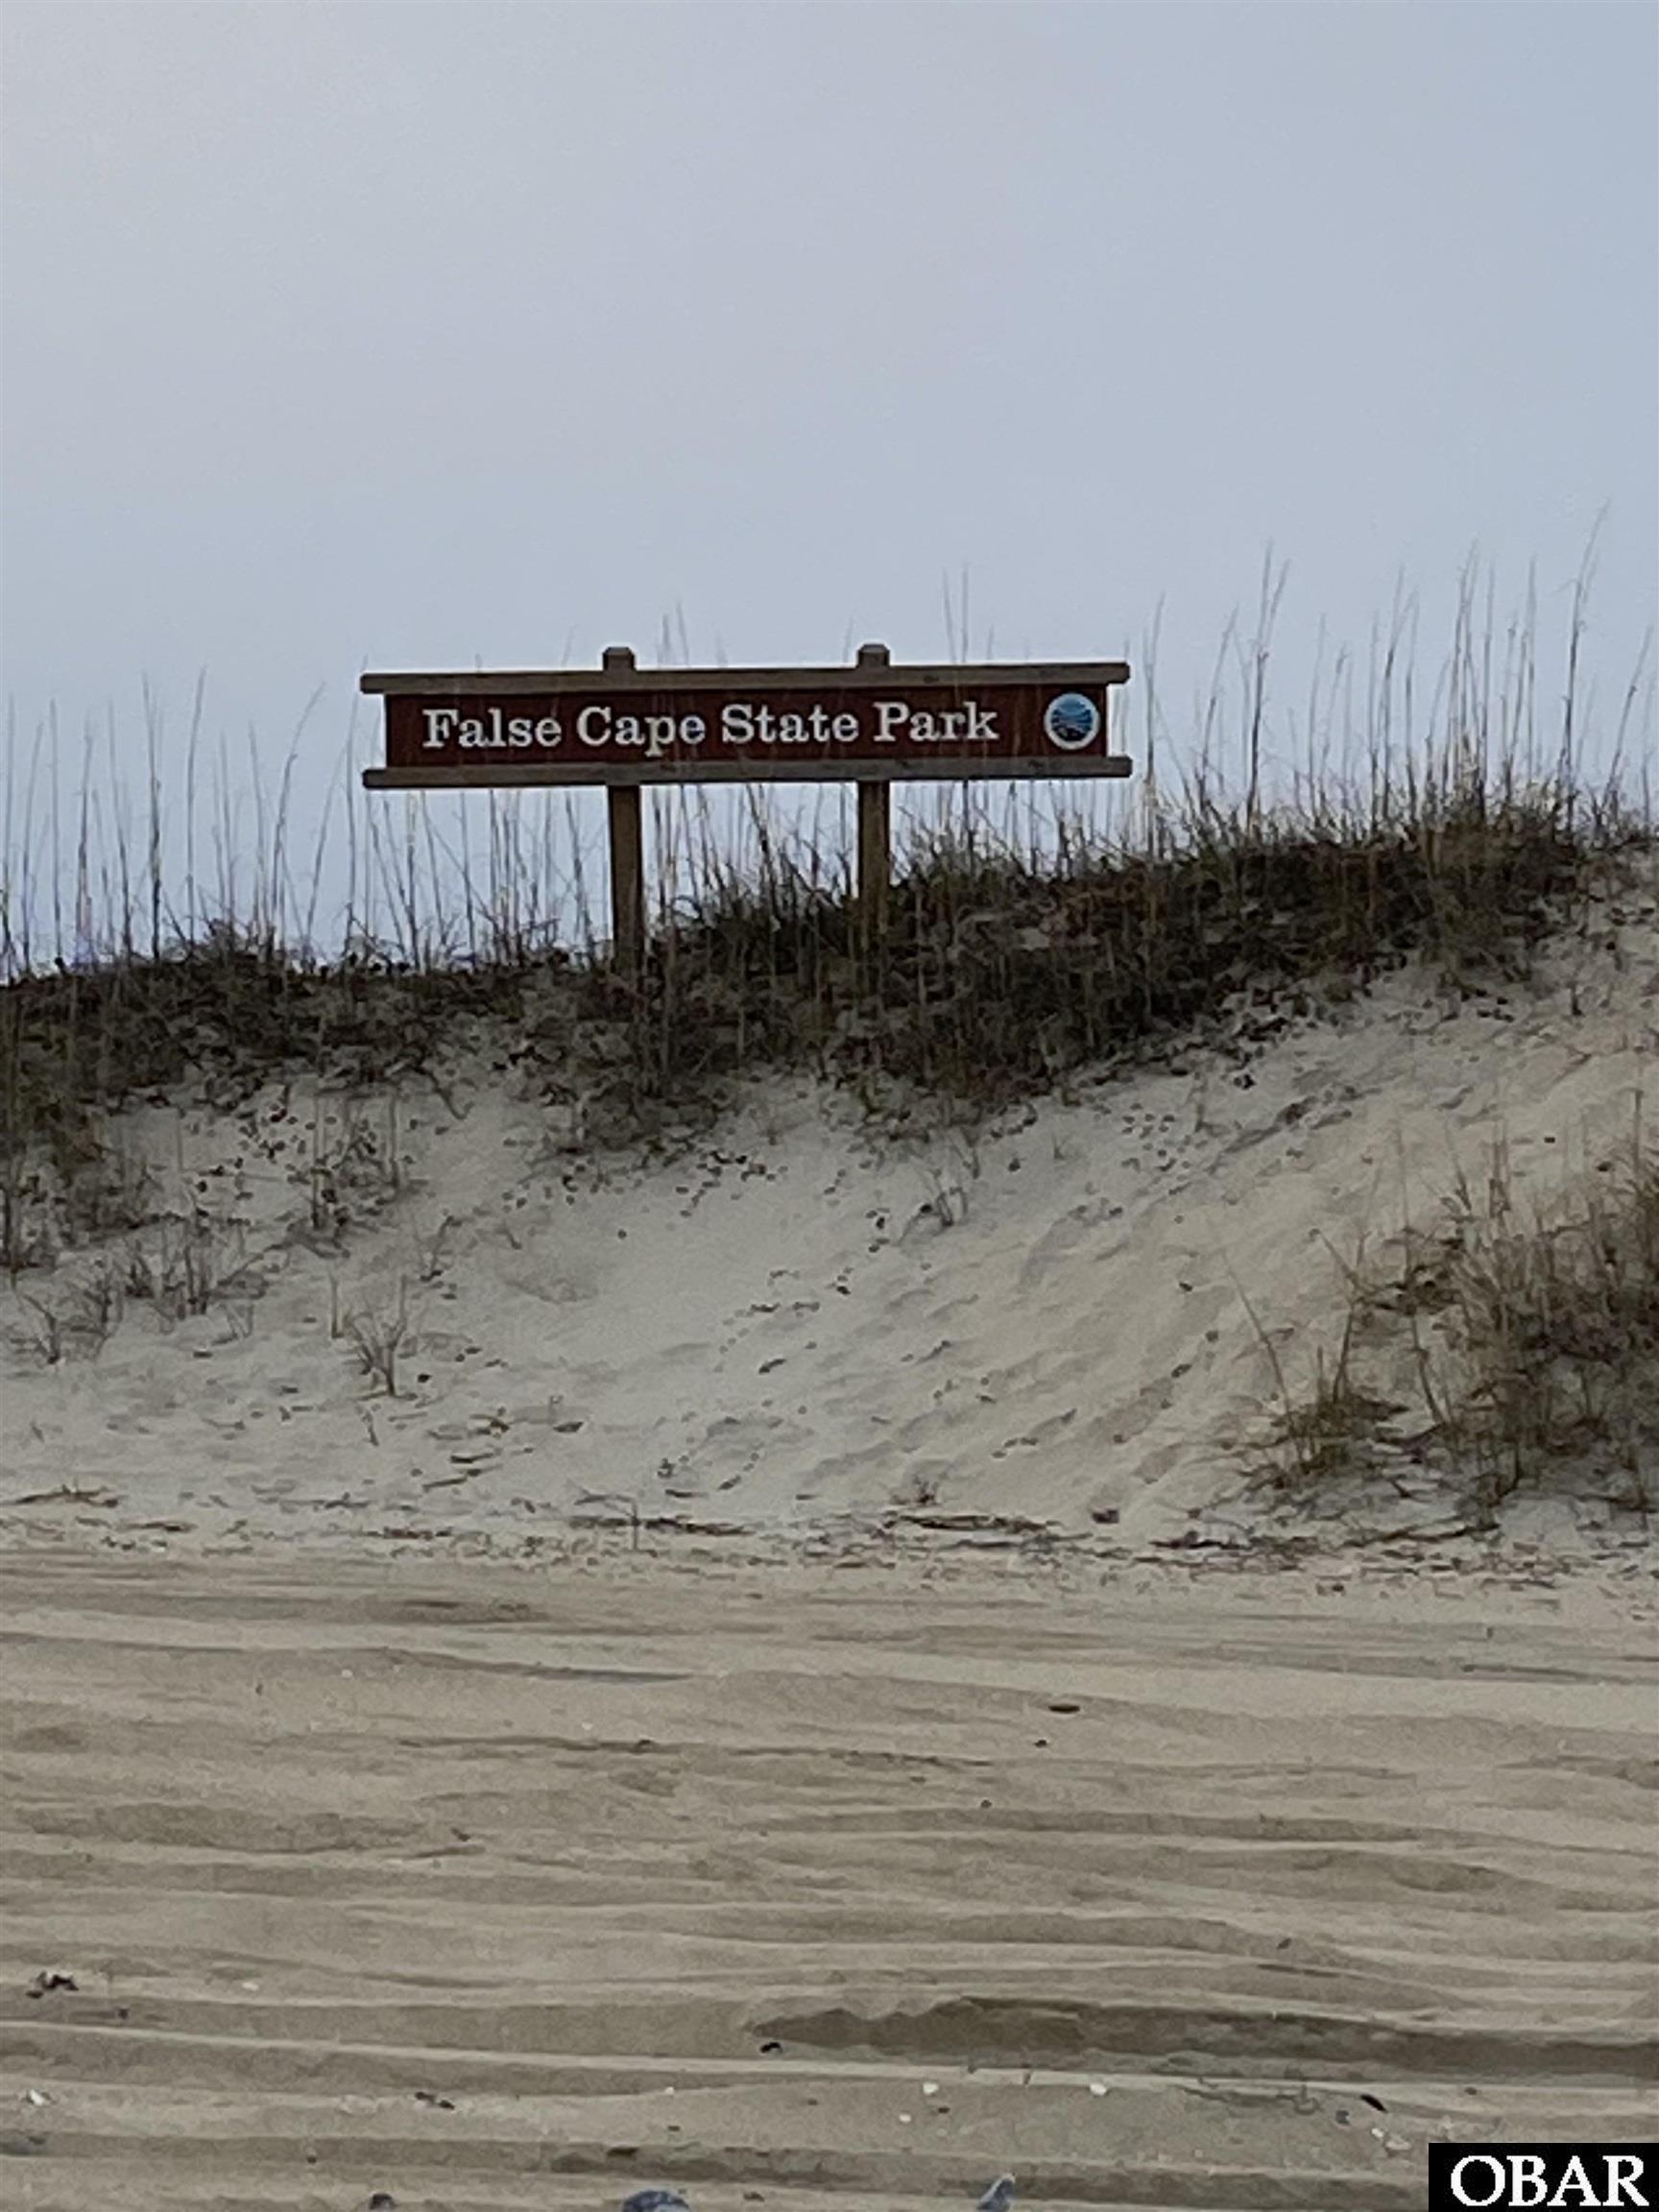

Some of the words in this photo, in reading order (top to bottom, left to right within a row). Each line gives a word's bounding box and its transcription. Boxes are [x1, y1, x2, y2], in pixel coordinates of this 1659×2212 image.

[422, 708, 562, 748] False
[576, 706, 706, 757] Cape
[721, 704, 859, 743] State
[873, 701, 999, 742] Park
